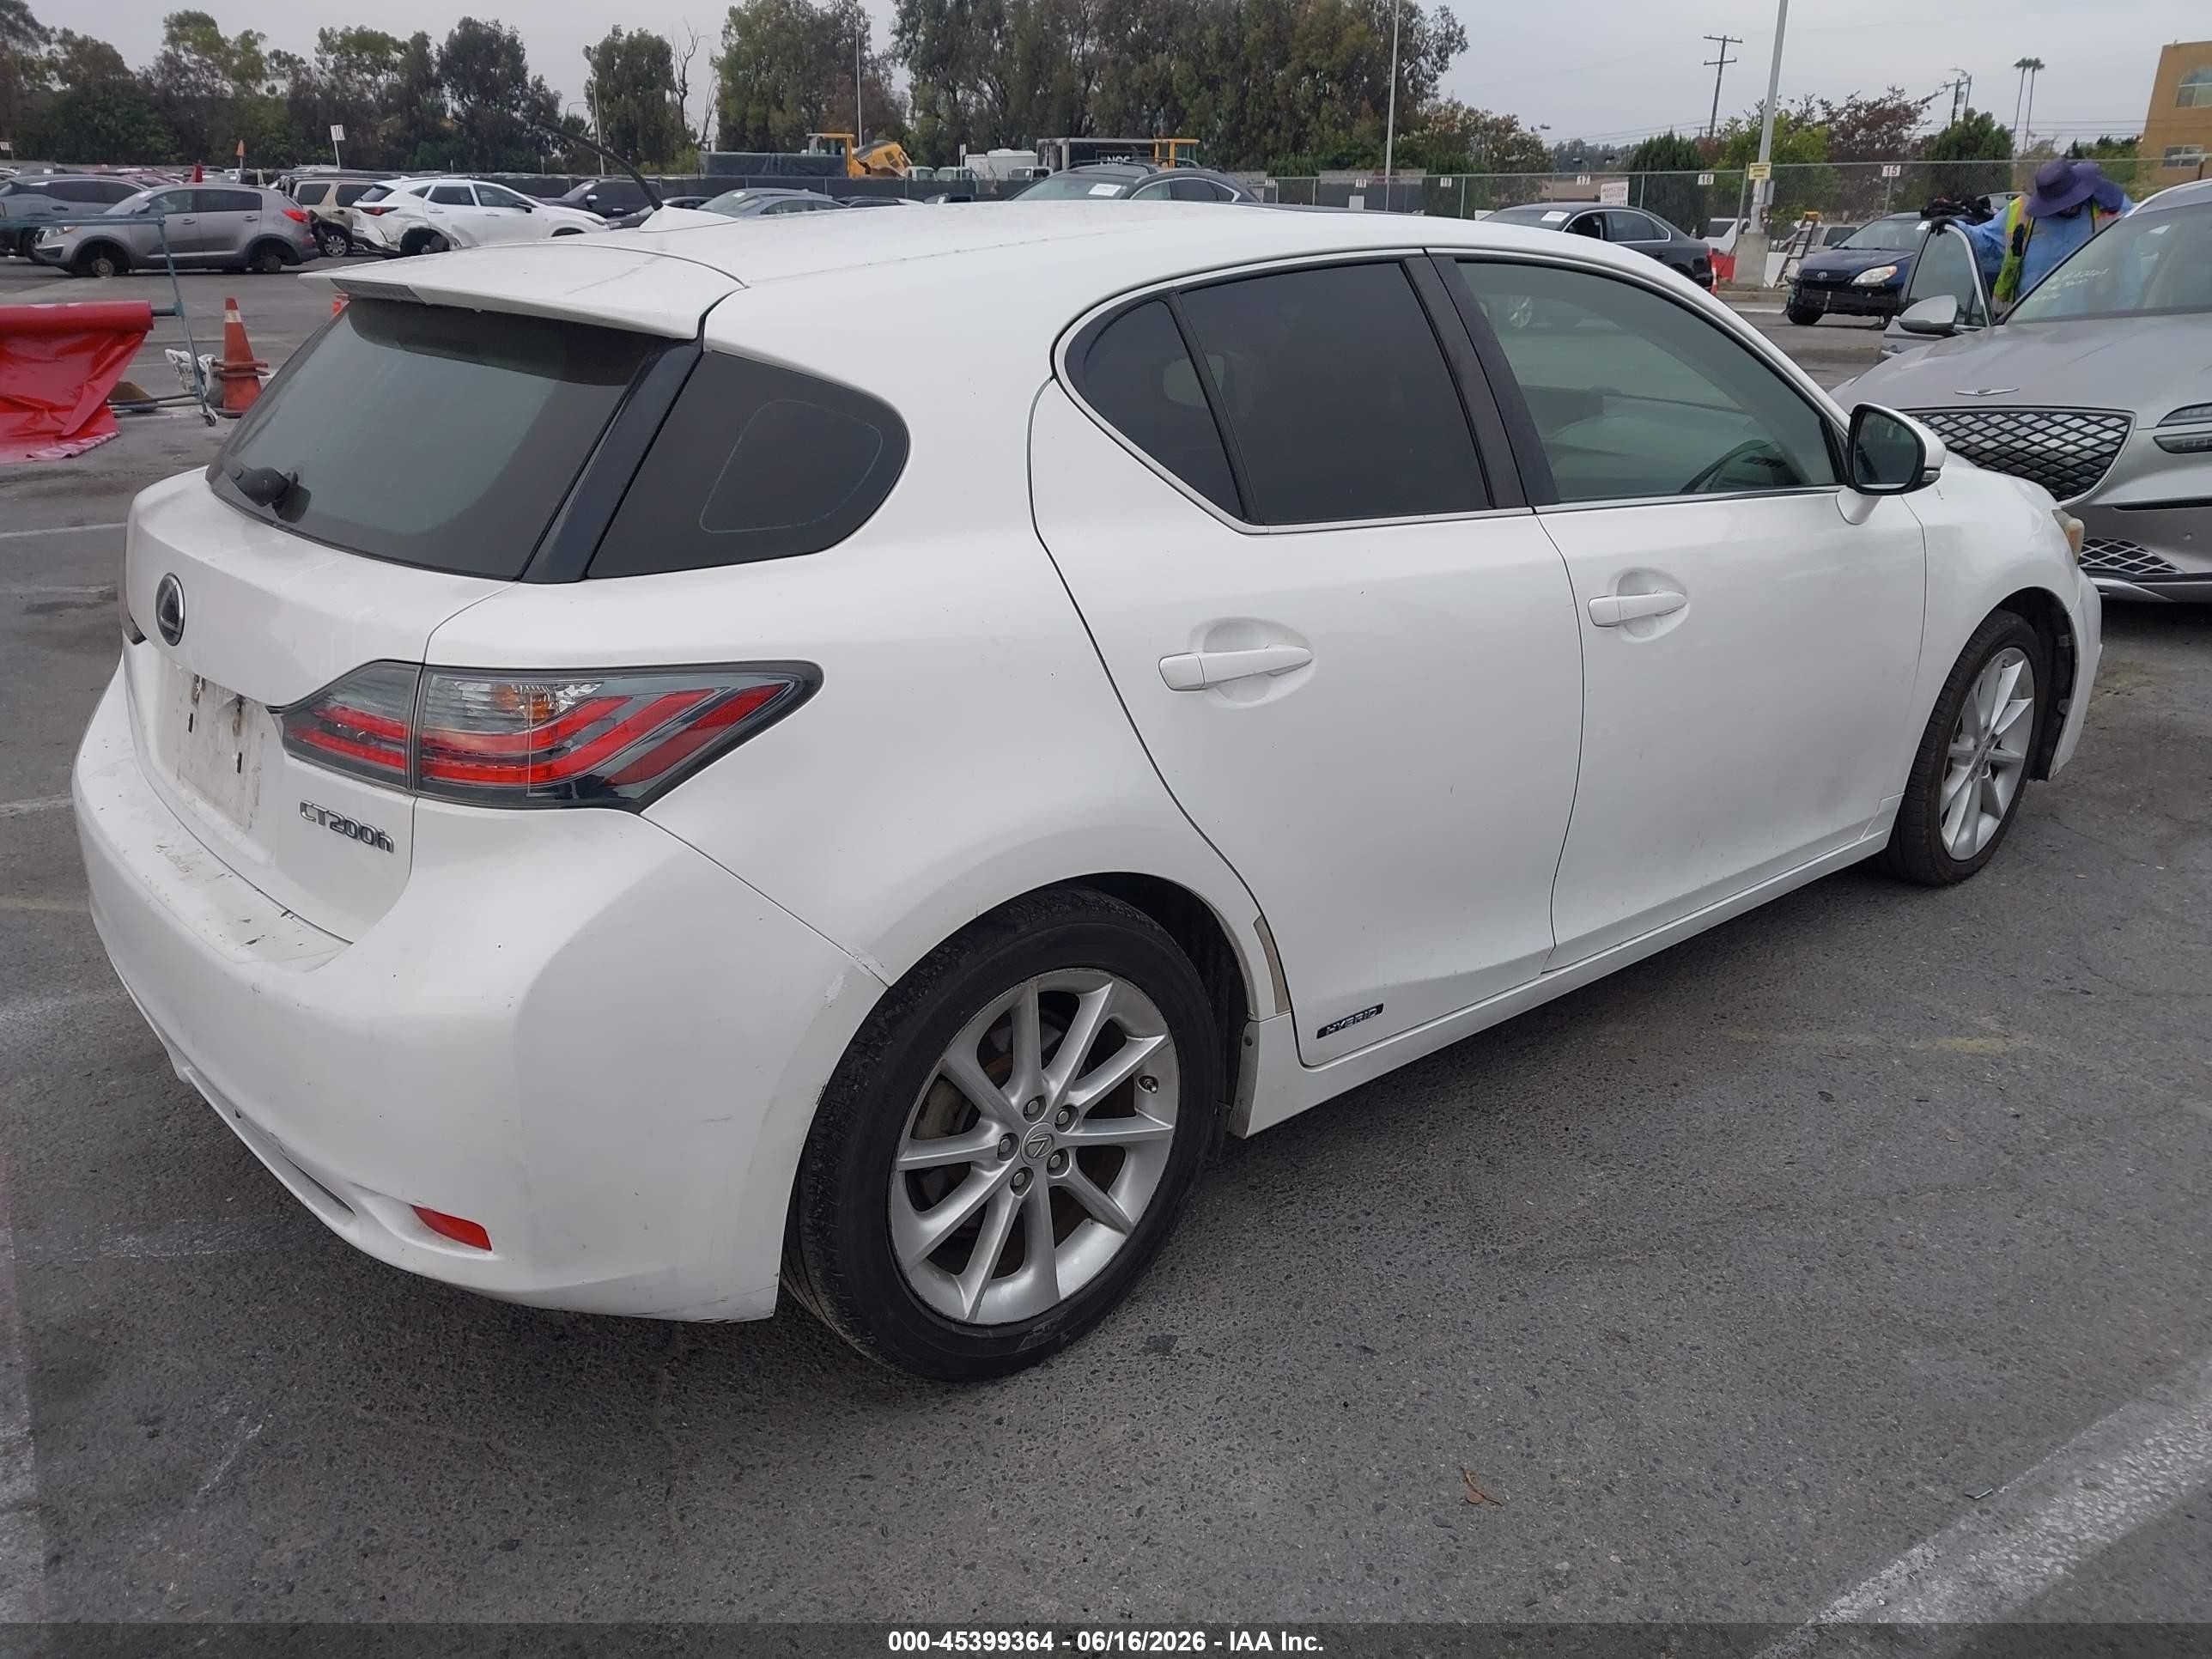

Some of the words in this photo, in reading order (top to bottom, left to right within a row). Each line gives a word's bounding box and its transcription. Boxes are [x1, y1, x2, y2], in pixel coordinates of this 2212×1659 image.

[1702, 174, 1712, 184] 16
[300, 799, 394, 853] CT200h
[1325, 1007, 1377, 1036] HYBRID
